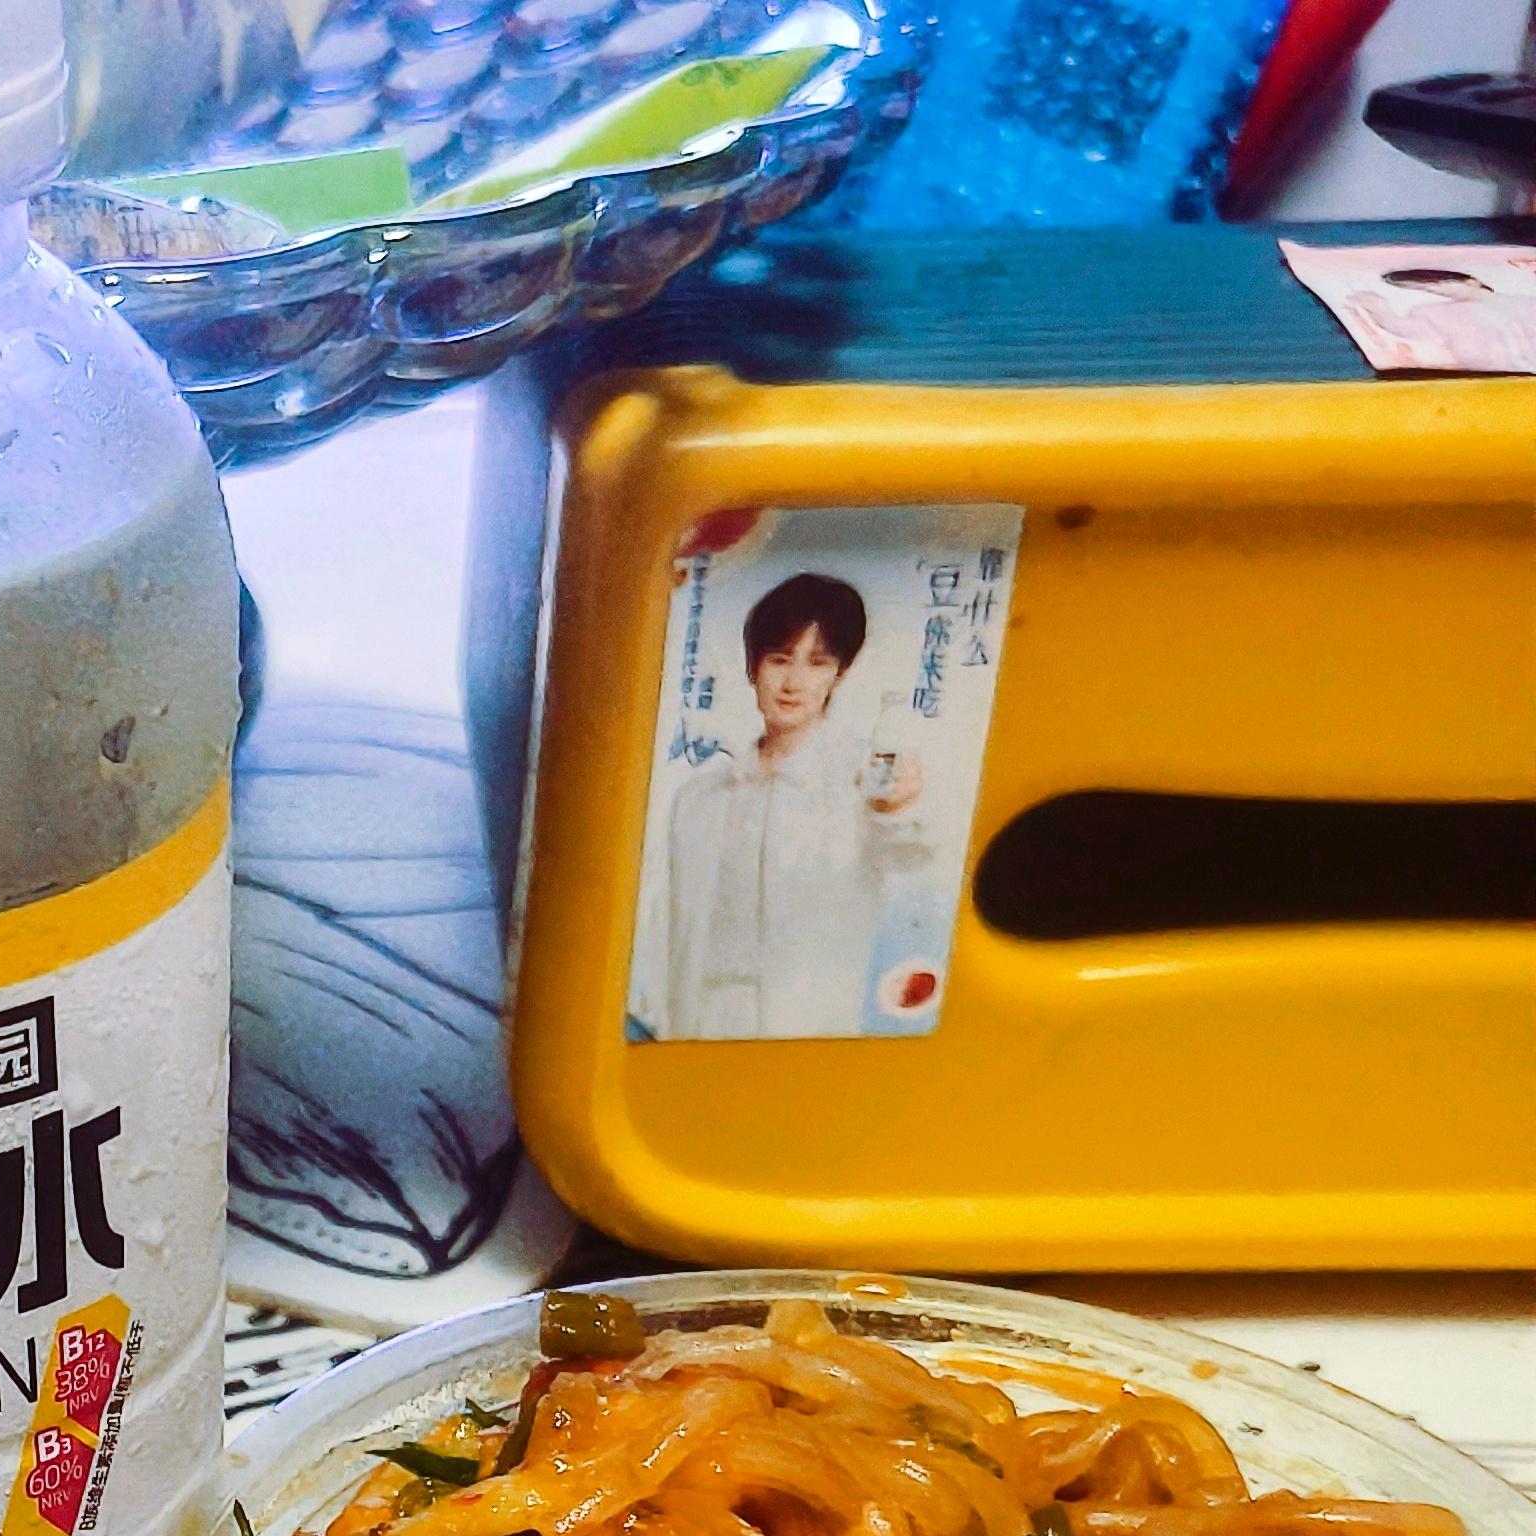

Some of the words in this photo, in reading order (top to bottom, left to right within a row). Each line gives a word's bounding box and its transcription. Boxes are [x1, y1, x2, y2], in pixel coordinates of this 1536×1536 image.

[63, 1329, 106, 1365] B12
[57, 1353, 110, 1398] 38%
[69, 1386, 100, 1414] NRV
[37, 1428, 71, 1463] B3
[28, 1455, 82, 1496] 60%
